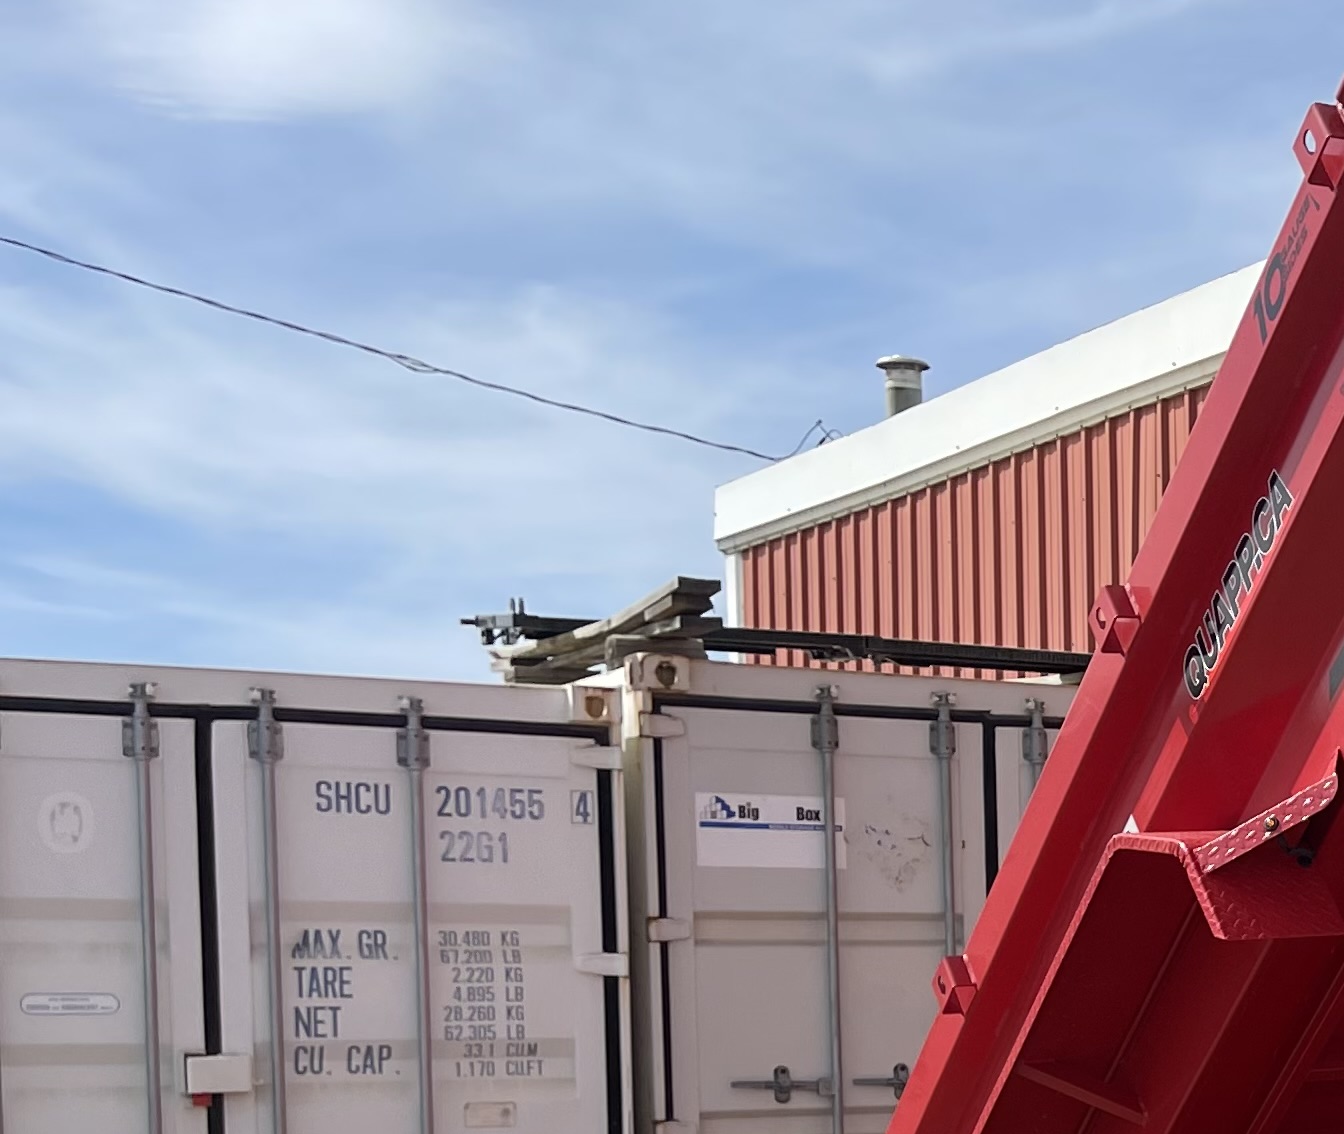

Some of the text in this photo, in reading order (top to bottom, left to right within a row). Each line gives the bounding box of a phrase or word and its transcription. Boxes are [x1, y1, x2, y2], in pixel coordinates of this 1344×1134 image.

[1253, 252, 1287, 345] 10
[1184, 469, 1294, 699] QUAPP.CA
[315, 780, 591, 823] SHCU 201455 4
[738, 802, 821, 821] Big Box
[439, 830, 509, 863] 22G1
[291, 929, 399, 960] MAX. GR.
[501, 930, 520, 947] KG
[503, 949, 522, 964] LB
[293, 966, 354, 998] TARE
[504, 967, 524, 982] KG
[505, 986, 524, 1002] LB
[294, 1006, 342, 1038] NET
[506, 1005, 525, 1021] KG
[507, 1025, 525, 1041] LB
[294, 1045, 400, 1075] CU. CAP.
